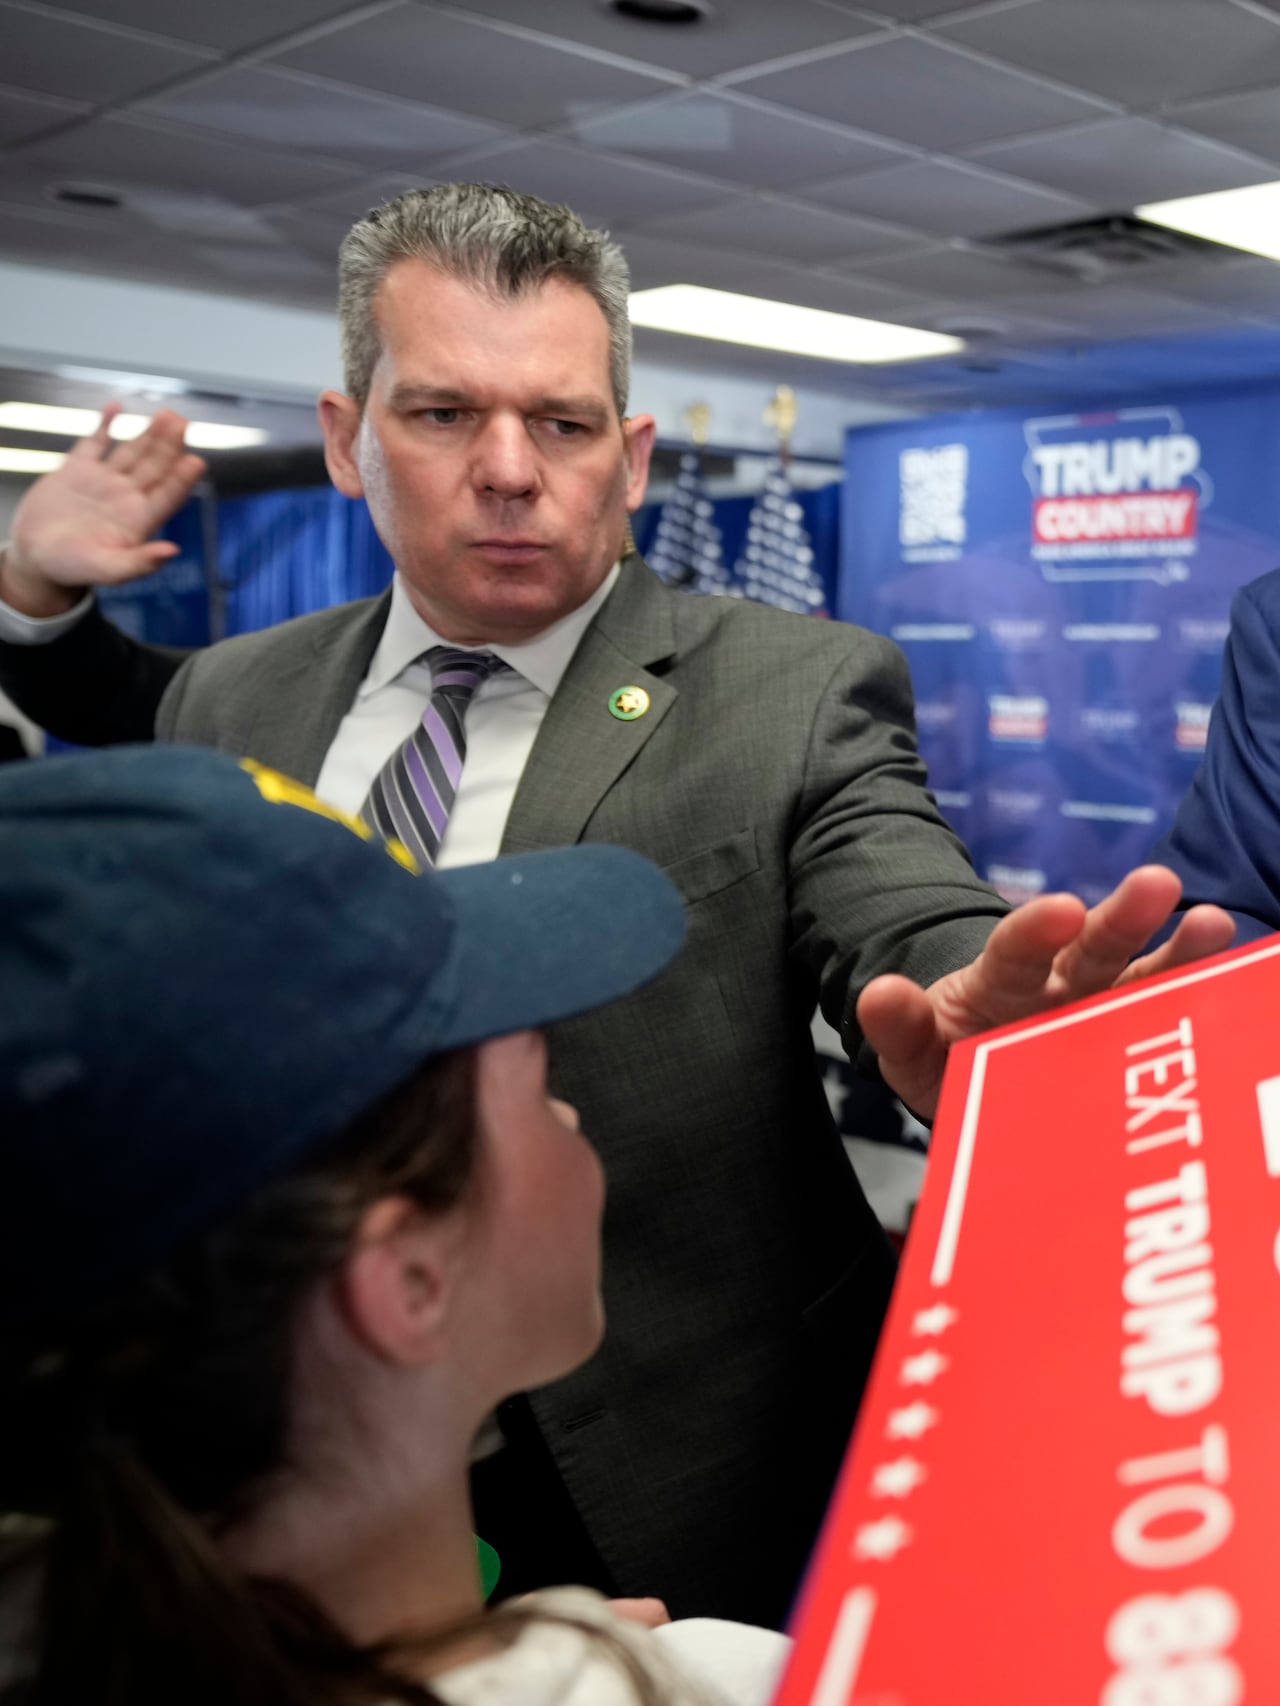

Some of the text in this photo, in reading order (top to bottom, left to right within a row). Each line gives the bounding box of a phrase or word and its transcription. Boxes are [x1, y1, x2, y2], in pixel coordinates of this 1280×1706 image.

[1032, 433, 1201, 498] TRUMP
[1036, 494, 1192, 542] COUNTRY
[1124, 1016, 1203, 1155] TEXT
[1120, 1159, 1224, 1417] TRUMP
[1112, 1424, 1236, 1569] TO
